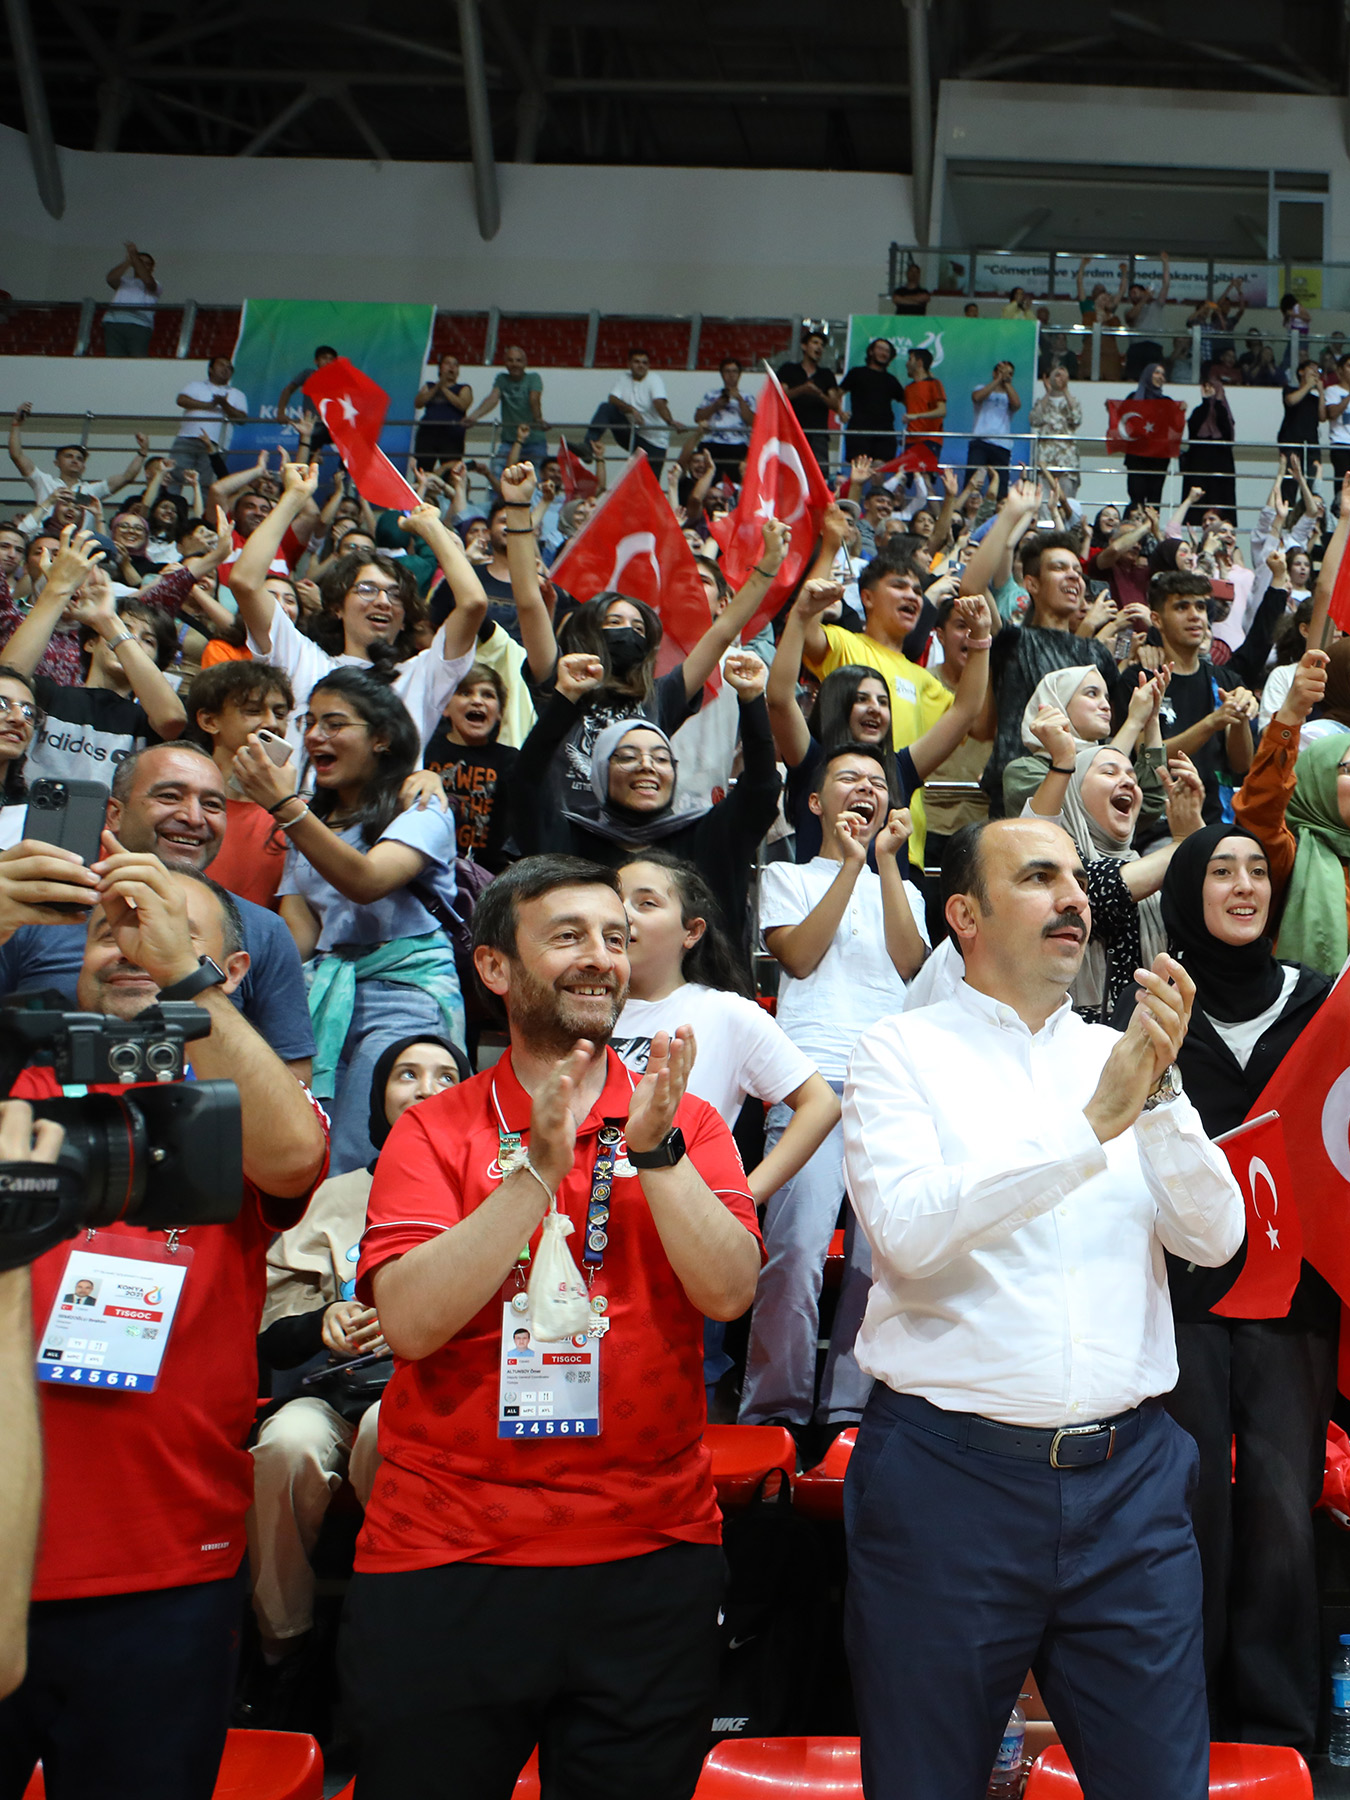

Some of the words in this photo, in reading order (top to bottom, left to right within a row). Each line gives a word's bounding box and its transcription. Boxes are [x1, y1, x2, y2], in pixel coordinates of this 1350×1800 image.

[1071, 268, 1114, 279] yrdım
[117, 1284, 144, 1293] KONYA
[114, 1308, 152, 1320] TISGOC
[551, 1355, 582, 1363] TISGOC
